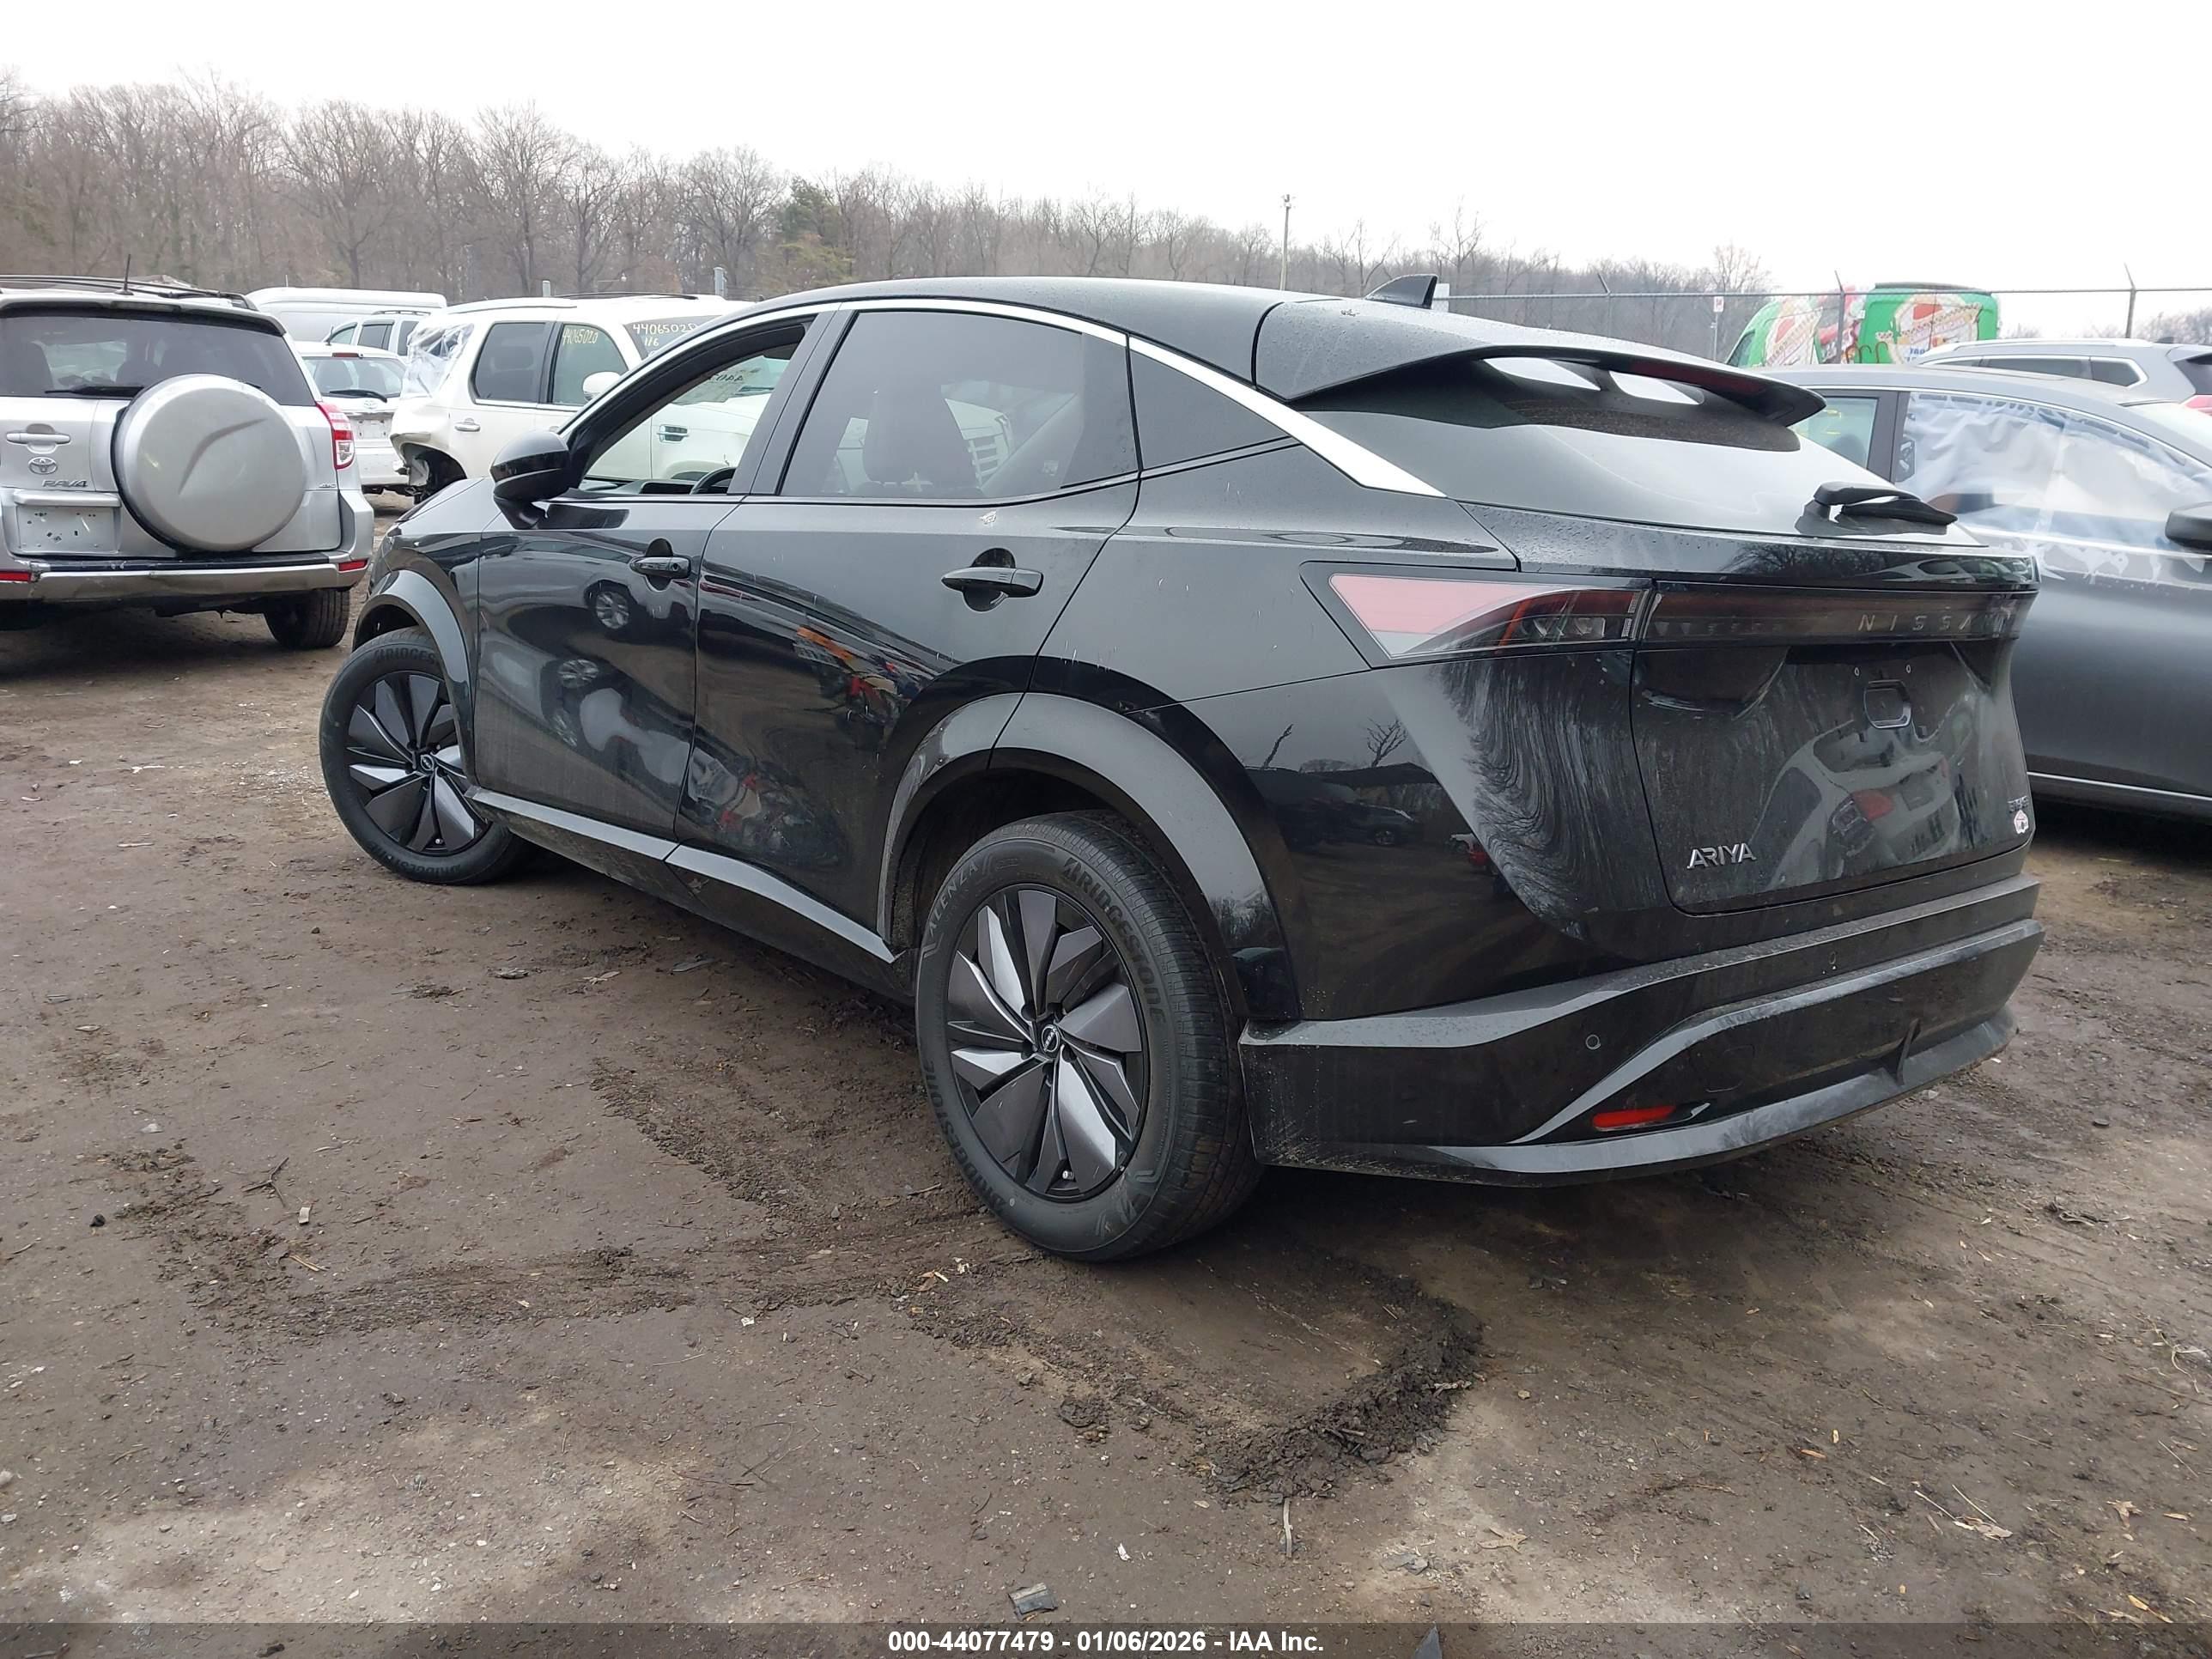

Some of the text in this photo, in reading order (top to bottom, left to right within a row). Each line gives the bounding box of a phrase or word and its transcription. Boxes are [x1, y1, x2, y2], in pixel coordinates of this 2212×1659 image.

[562, 328, 599, 345] 44065020
[1686, 842, 1757, 869] ARIYA
[927, 860, 979, 939] ALENZA
[1062, 857, 1166, 1024] BRIDGESTONE
